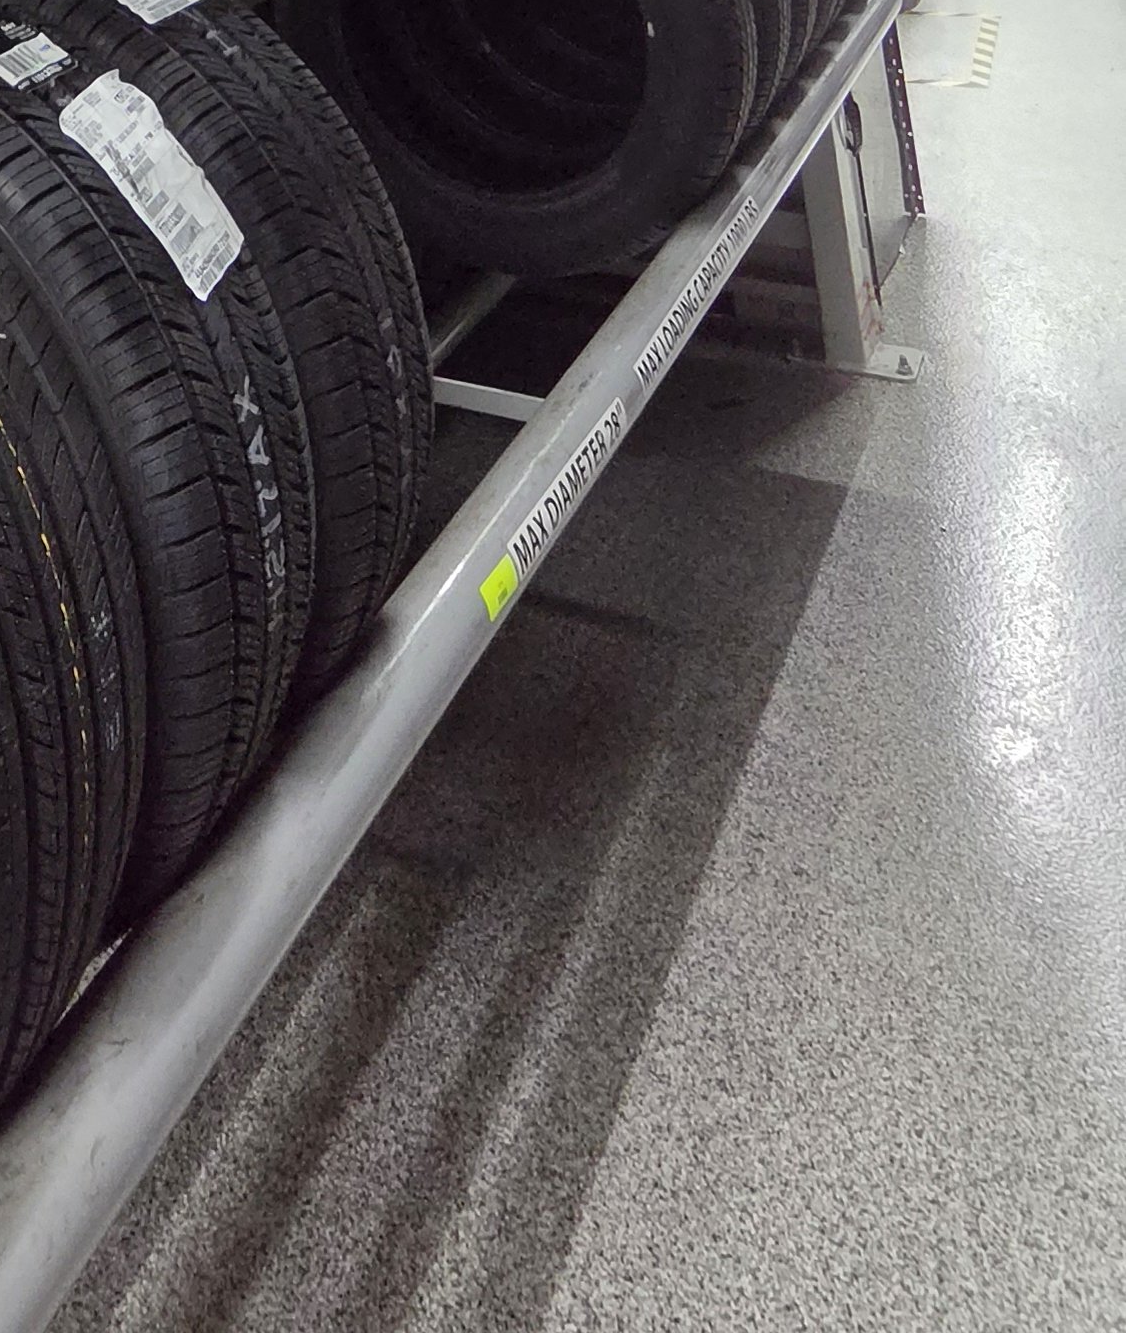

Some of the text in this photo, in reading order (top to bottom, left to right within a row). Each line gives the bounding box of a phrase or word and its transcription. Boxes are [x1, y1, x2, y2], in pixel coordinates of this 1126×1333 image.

[638, 341, 664, 387] MAX
[657, 289, 700, 357] LOADING
[693, 240, 733, 304] CAPACITY
[512, 514, 548, 576] MAX
[545, 429, 610, 524] DIAMETER
